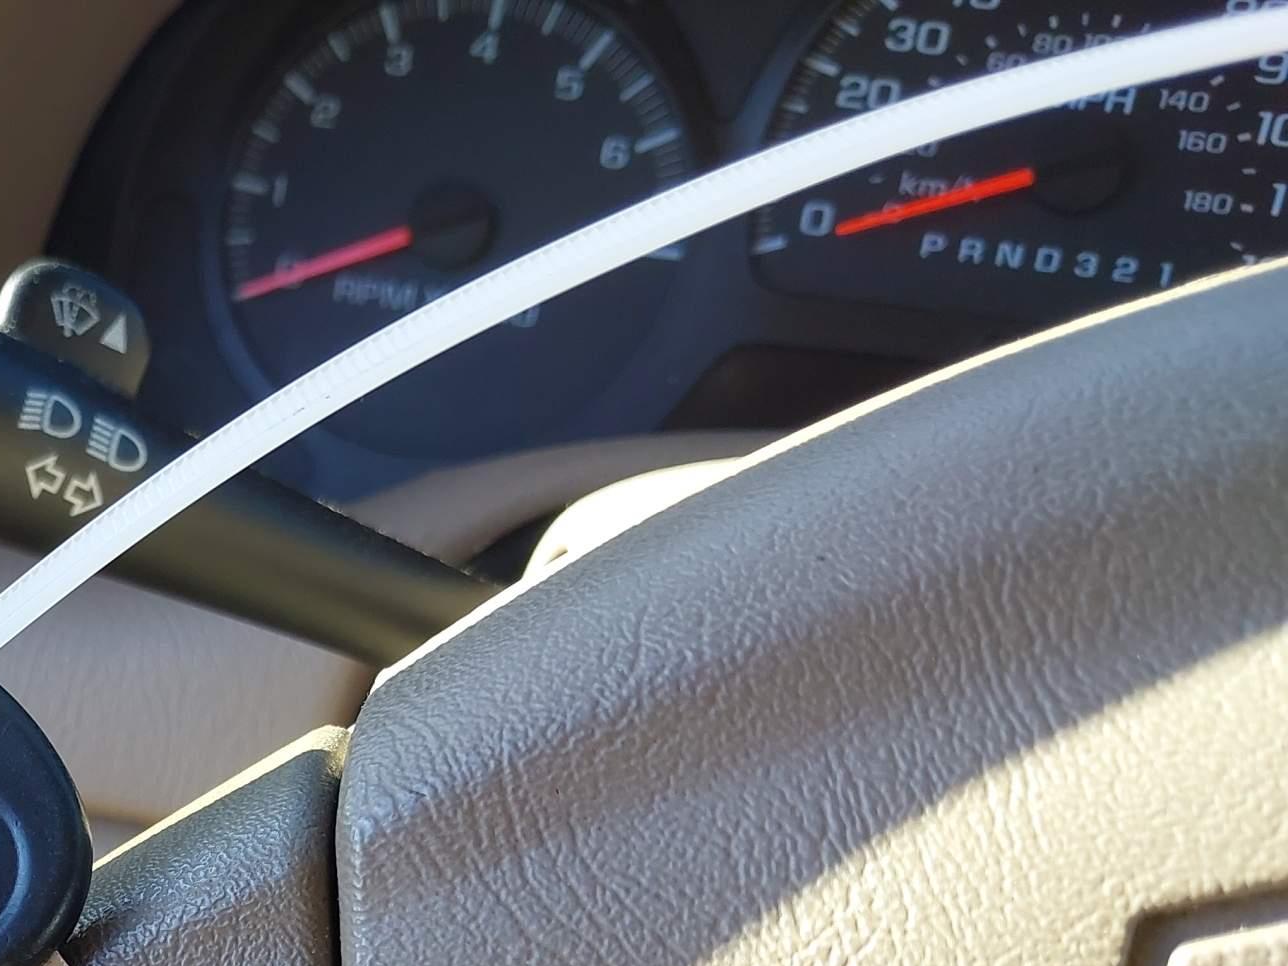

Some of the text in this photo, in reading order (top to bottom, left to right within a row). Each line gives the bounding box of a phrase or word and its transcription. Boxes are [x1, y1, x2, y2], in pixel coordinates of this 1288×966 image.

[470, 31, 500, 64] 4
[884, 17, 952, 56] 30
[1032, 33, 1074, 54] 80
[384, 43, 414, 77] 3
[554, 64, 585, 100] 5
[834, 73, 902, 110] 20
[311, 95, 342, 129] 2
[1159, 88, 1210, 113] 140
[599, 135, 631, 170] 6
[1177, 129, 1228, 154] 160
[799, 200, 835, 236] 0
[1183, 189, 1234, 215] 180
[919, 231, 949, 259] P
[958, 236, 987, 265] R
[995, 240, 1028, 270] N
[1034, 245, 1063, 274] D
[1073, 250, 1101, 279] 3
[1112, 255, 1141, 284] 2
